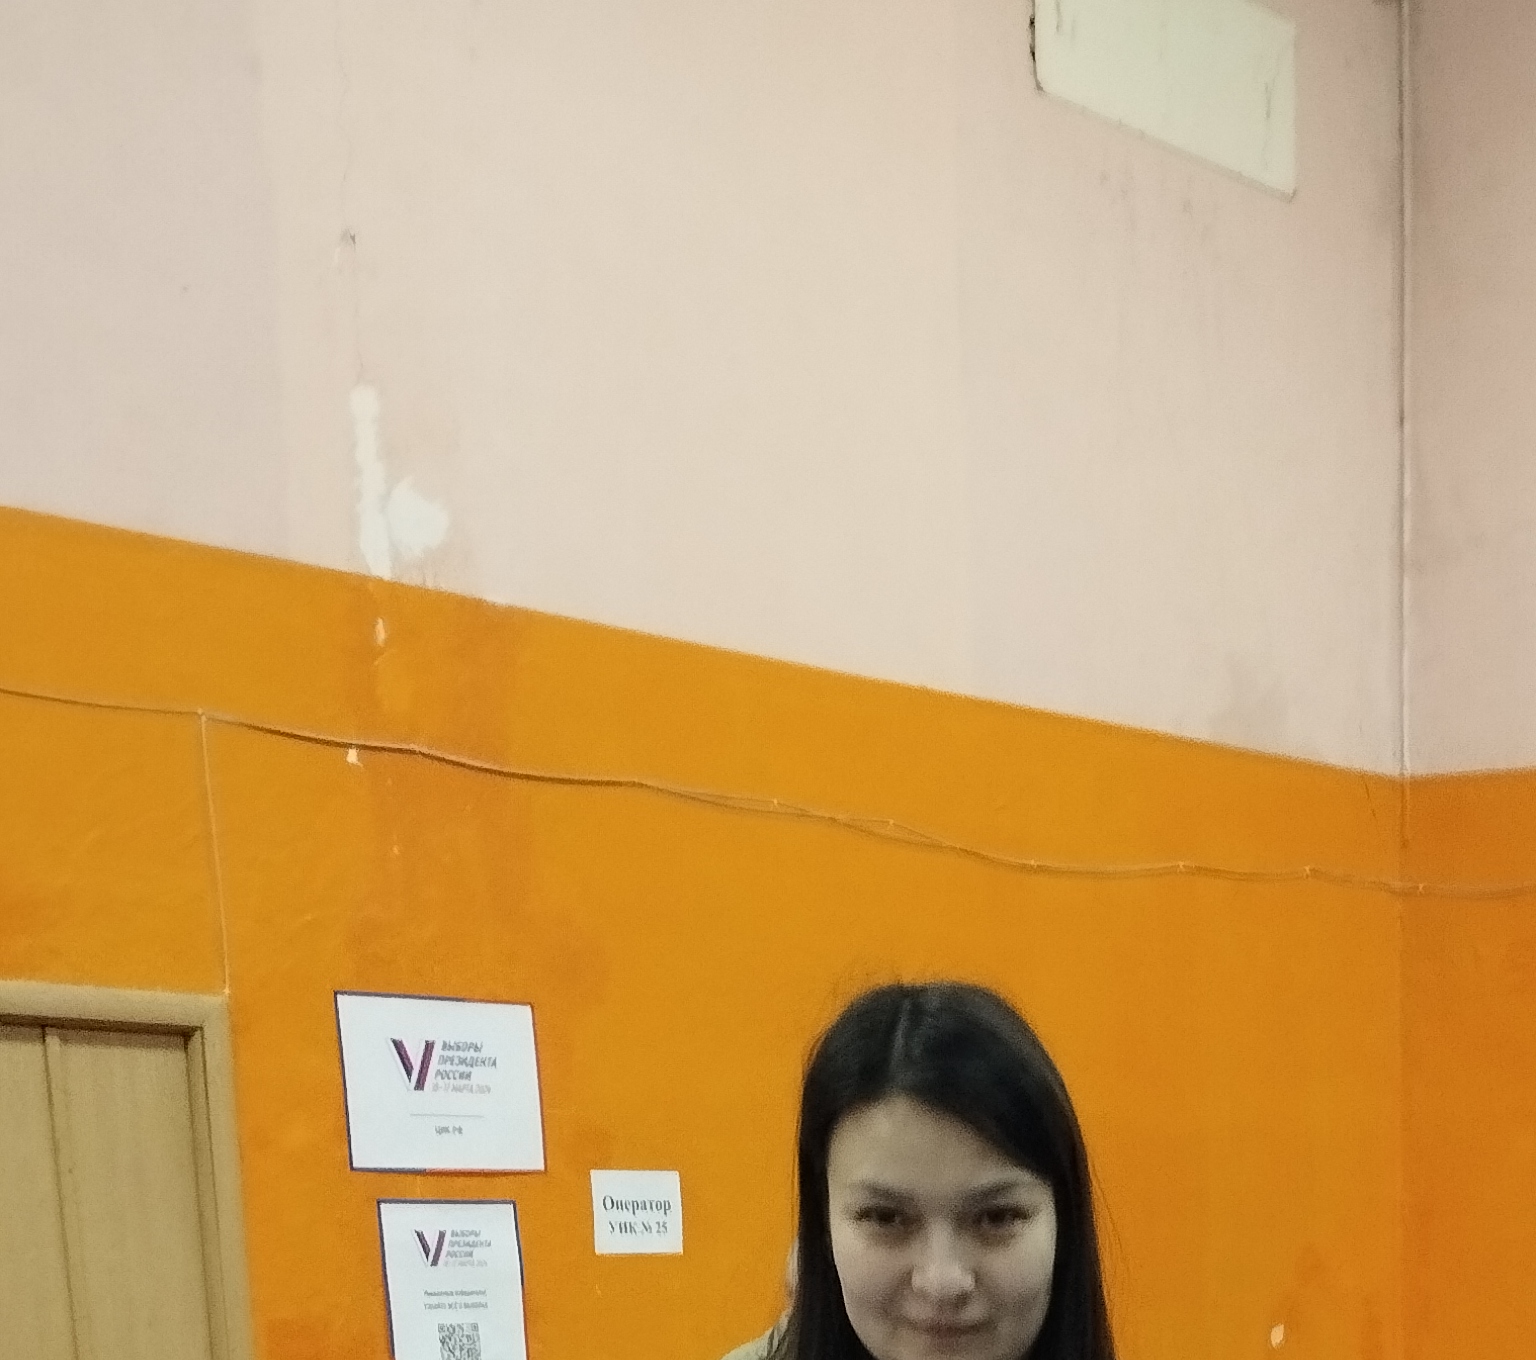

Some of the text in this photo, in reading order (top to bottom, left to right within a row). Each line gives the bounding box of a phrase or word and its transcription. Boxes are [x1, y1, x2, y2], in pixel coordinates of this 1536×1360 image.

[441, 1040, 483, 1053] ВЫБОРЫ
[437, 1054, 497, 1068] ПРЕЗИДЕНТА
[434, 1068, 472, 1081] РОССИИ
[602, 1194, 672, 1216] Оператор
